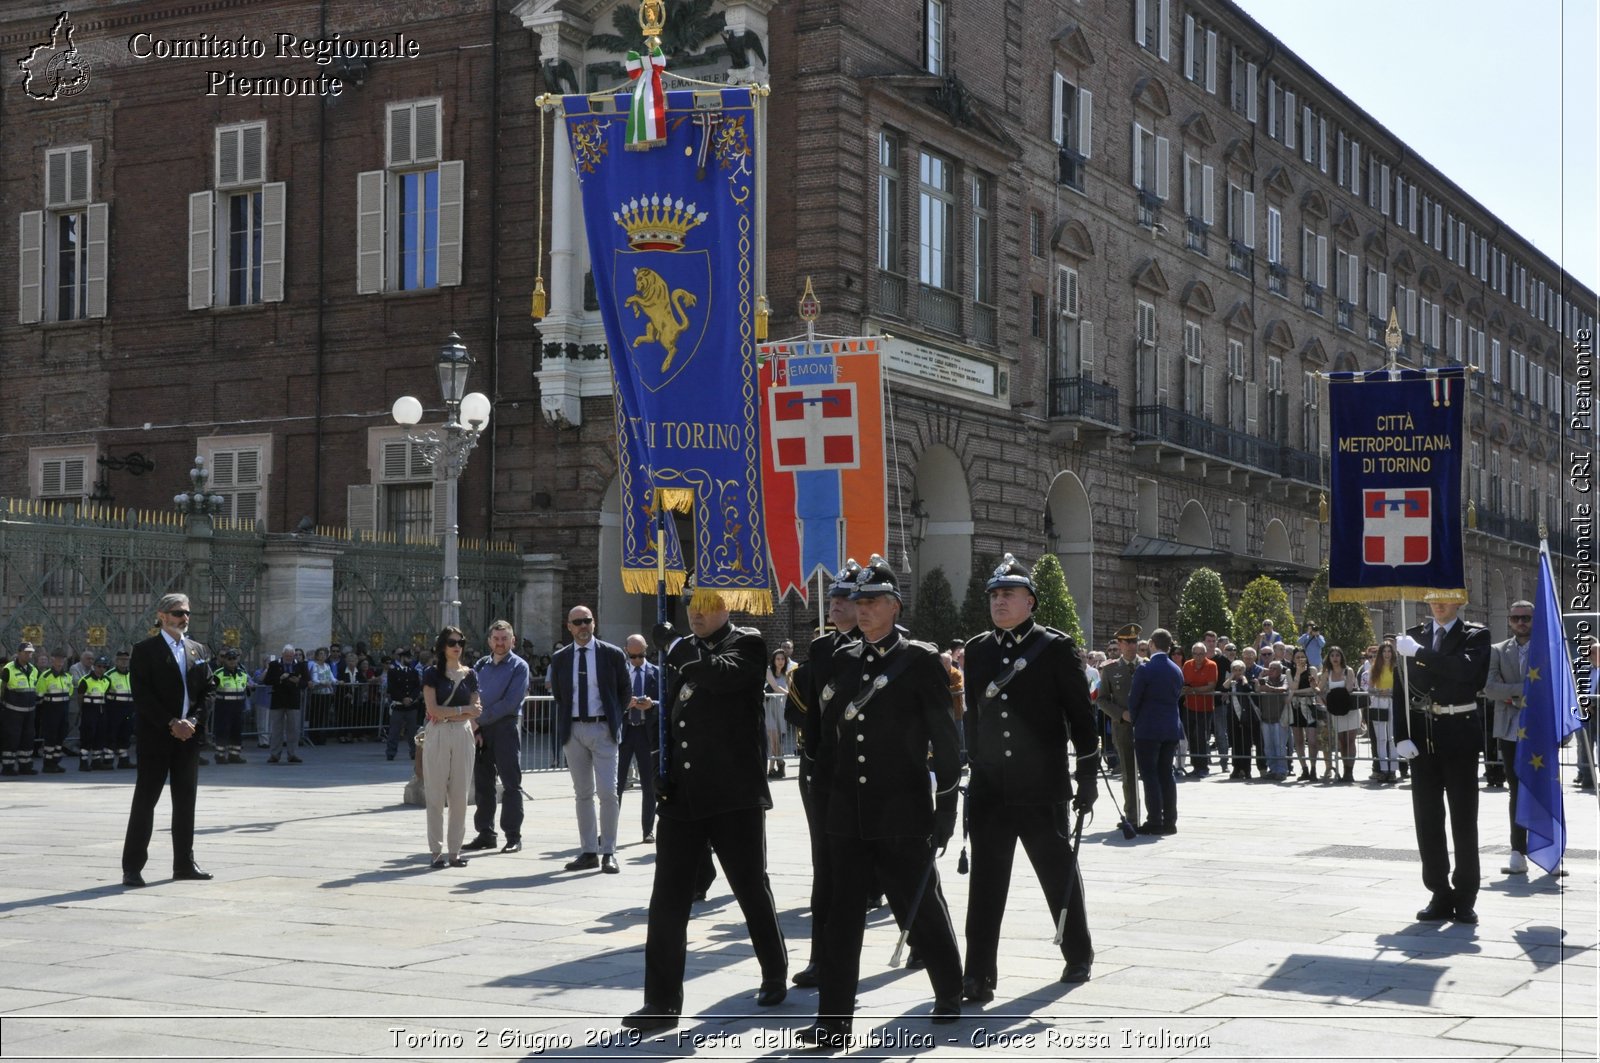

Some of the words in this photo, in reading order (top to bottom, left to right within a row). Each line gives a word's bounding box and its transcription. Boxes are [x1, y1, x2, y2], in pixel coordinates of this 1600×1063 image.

[779, 363, 844, 380] PEMONTE
[1377, 411, 1414, 431] CITTÀ
[662, 422, 740, 451] TORINO
[1339, 435, 1451, 452] METROPOLITANA
[1363, 458, 1375, 473] DI
[1379, 457, 1431, 473] TORINO
